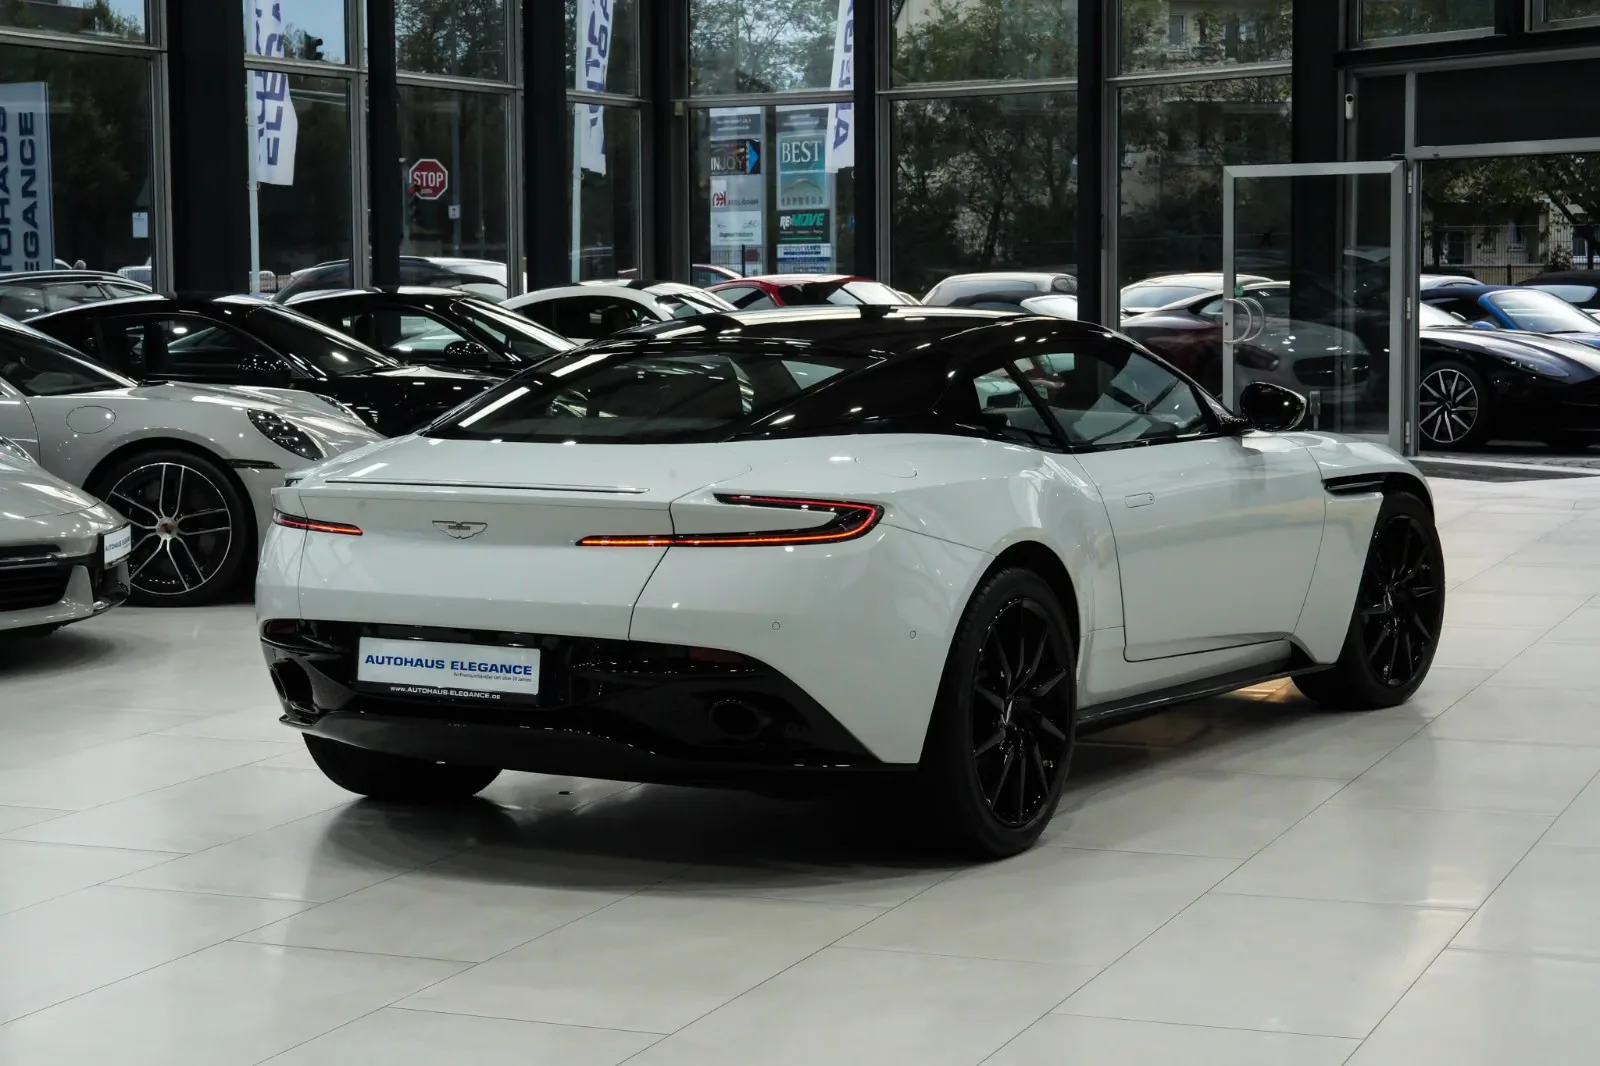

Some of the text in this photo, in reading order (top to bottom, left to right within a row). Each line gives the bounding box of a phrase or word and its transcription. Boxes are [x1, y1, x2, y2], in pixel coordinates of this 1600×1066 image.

[782, 140, 822, 163] BEST
[710, 155, 744, 171] INJOY
[413, 171, 444, 188] STOP
[365, 655, 532, 675] AUTOHAUS ELEGANCE
